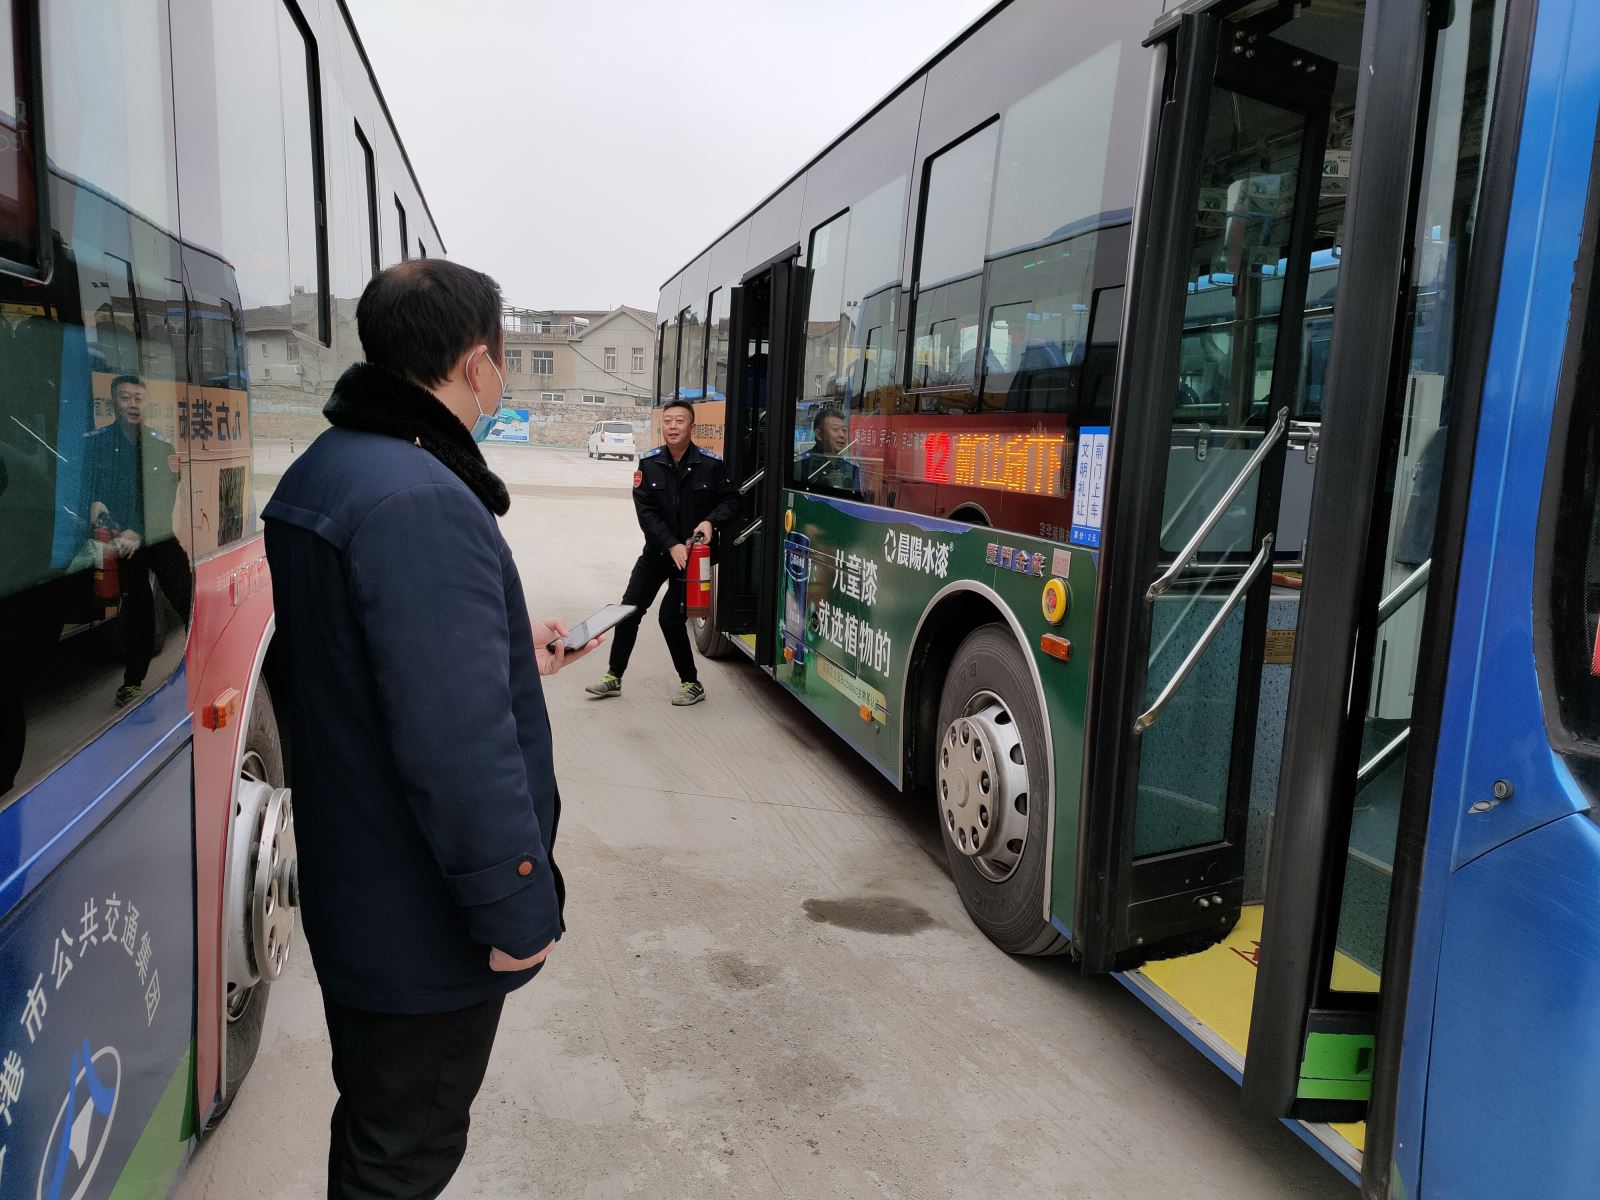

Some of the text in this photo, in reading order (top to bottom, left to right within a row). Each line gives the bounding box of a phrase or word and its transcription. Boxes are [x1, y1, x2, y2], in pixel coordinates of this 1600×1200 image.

[924, 432, 951, 484] 12
[1076, 441, 1090, 517] 文明礼让
[1090, 442, 1104, 519] 前门上车
[832, 548, 878, 606] 儿童漆
[817, 599, 892, 678] 就选植物的
[0, 892, 161, 1182] 港市公共交通集团
